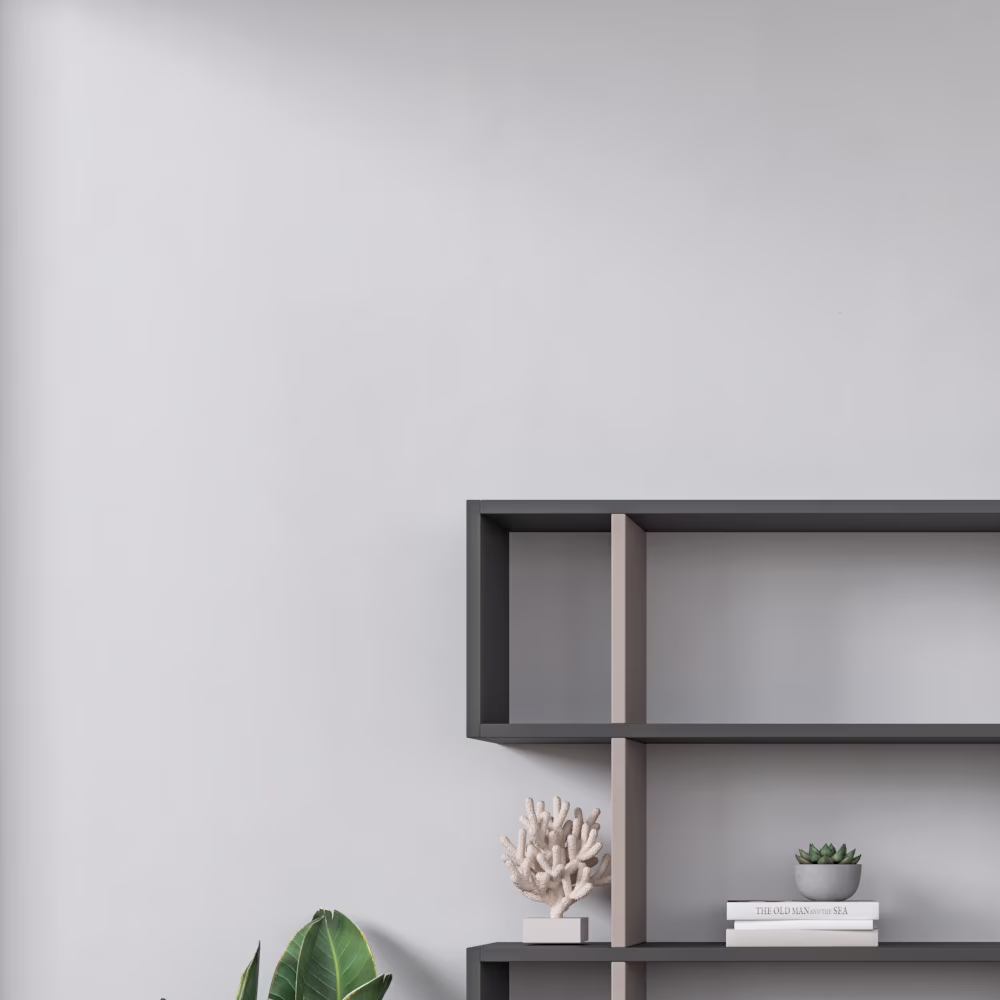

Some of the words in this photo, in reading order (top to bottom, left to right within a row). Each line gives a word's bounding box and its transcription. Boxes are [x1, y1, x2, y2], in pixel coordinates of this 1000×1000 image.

[756, 907, 772, 915] THE
[773, 907, 791, 915] OLD
[792, 907, 810, 915] MAN
[833, 906, 848, 915] SEA
